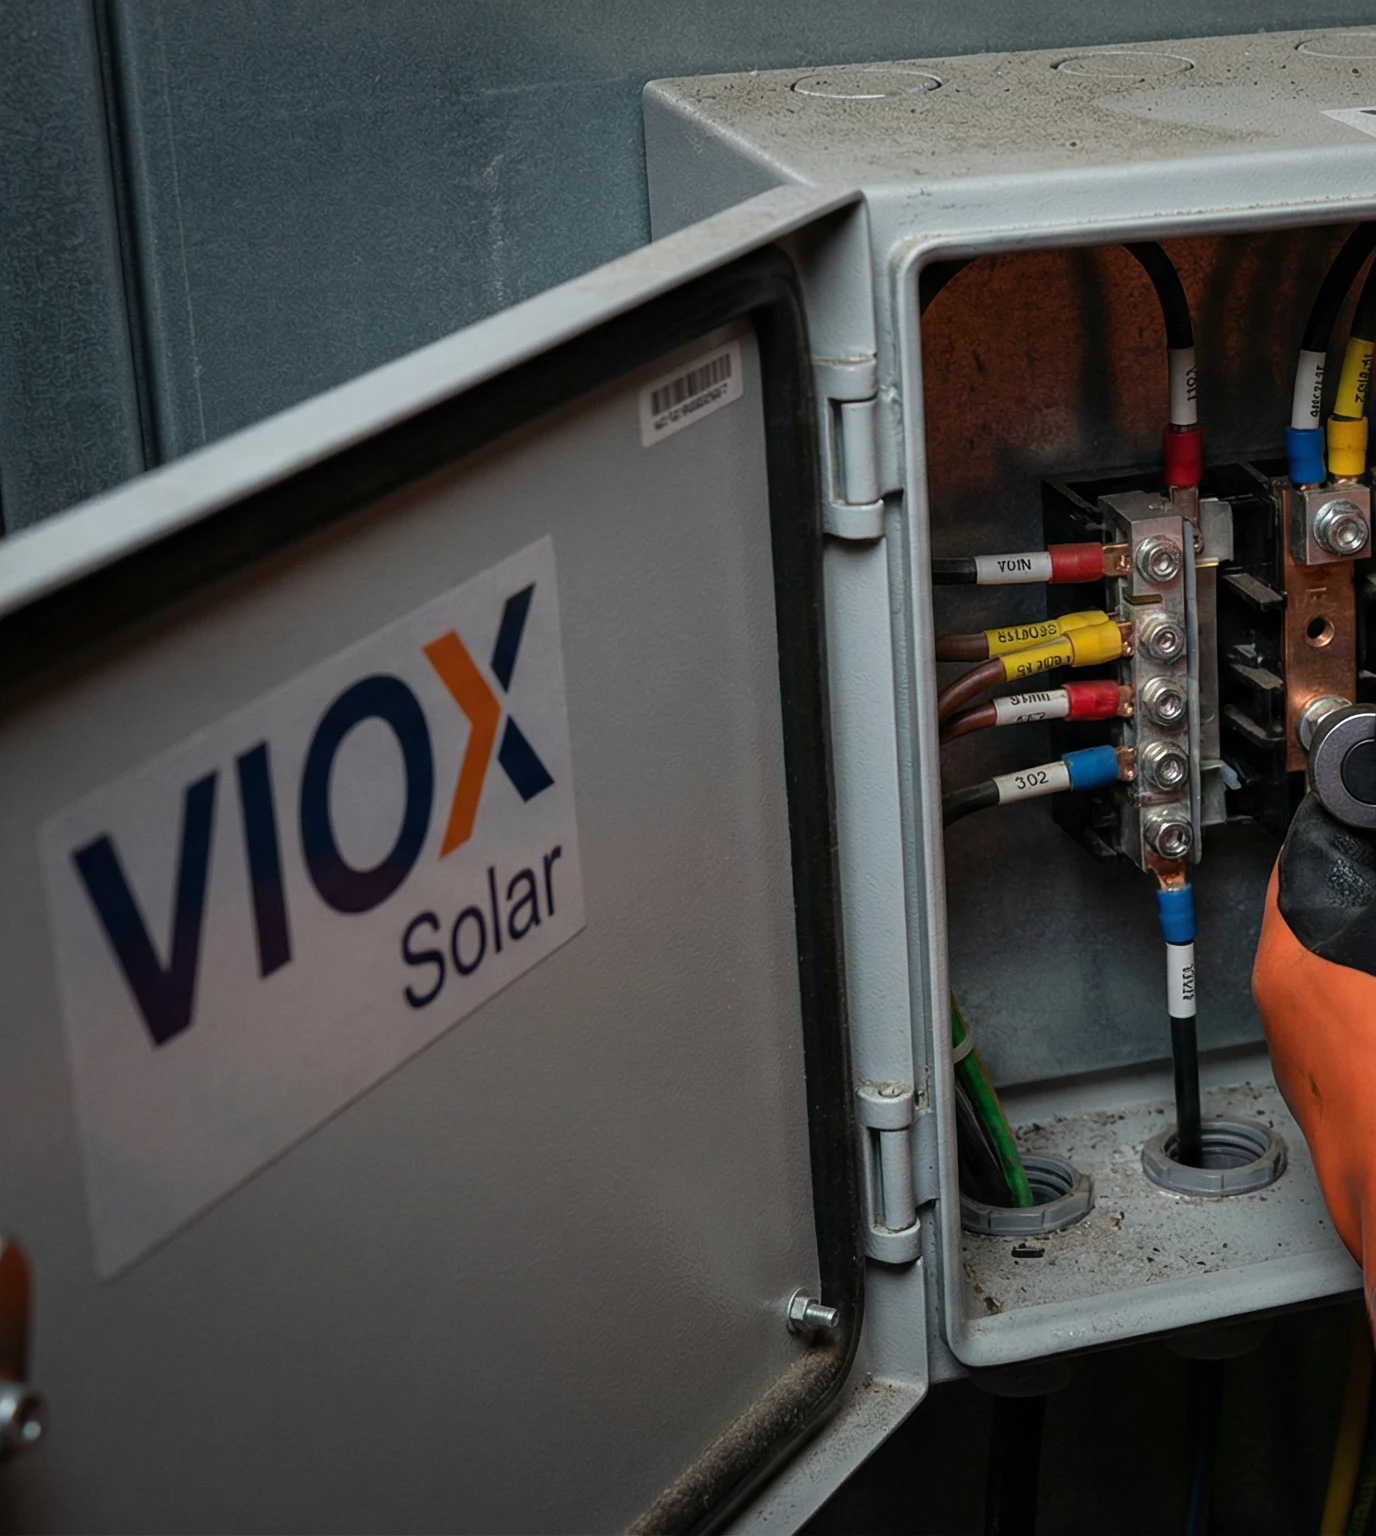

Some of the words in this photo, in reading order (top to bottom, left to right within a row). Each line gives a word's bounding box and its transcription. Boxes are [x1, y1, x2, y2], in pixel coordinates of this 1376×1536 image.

[72, 581, 556, 1049] VIOX
[1015, 770, 1049, 790] 302
[402, 845, 564, 1009] Solar
